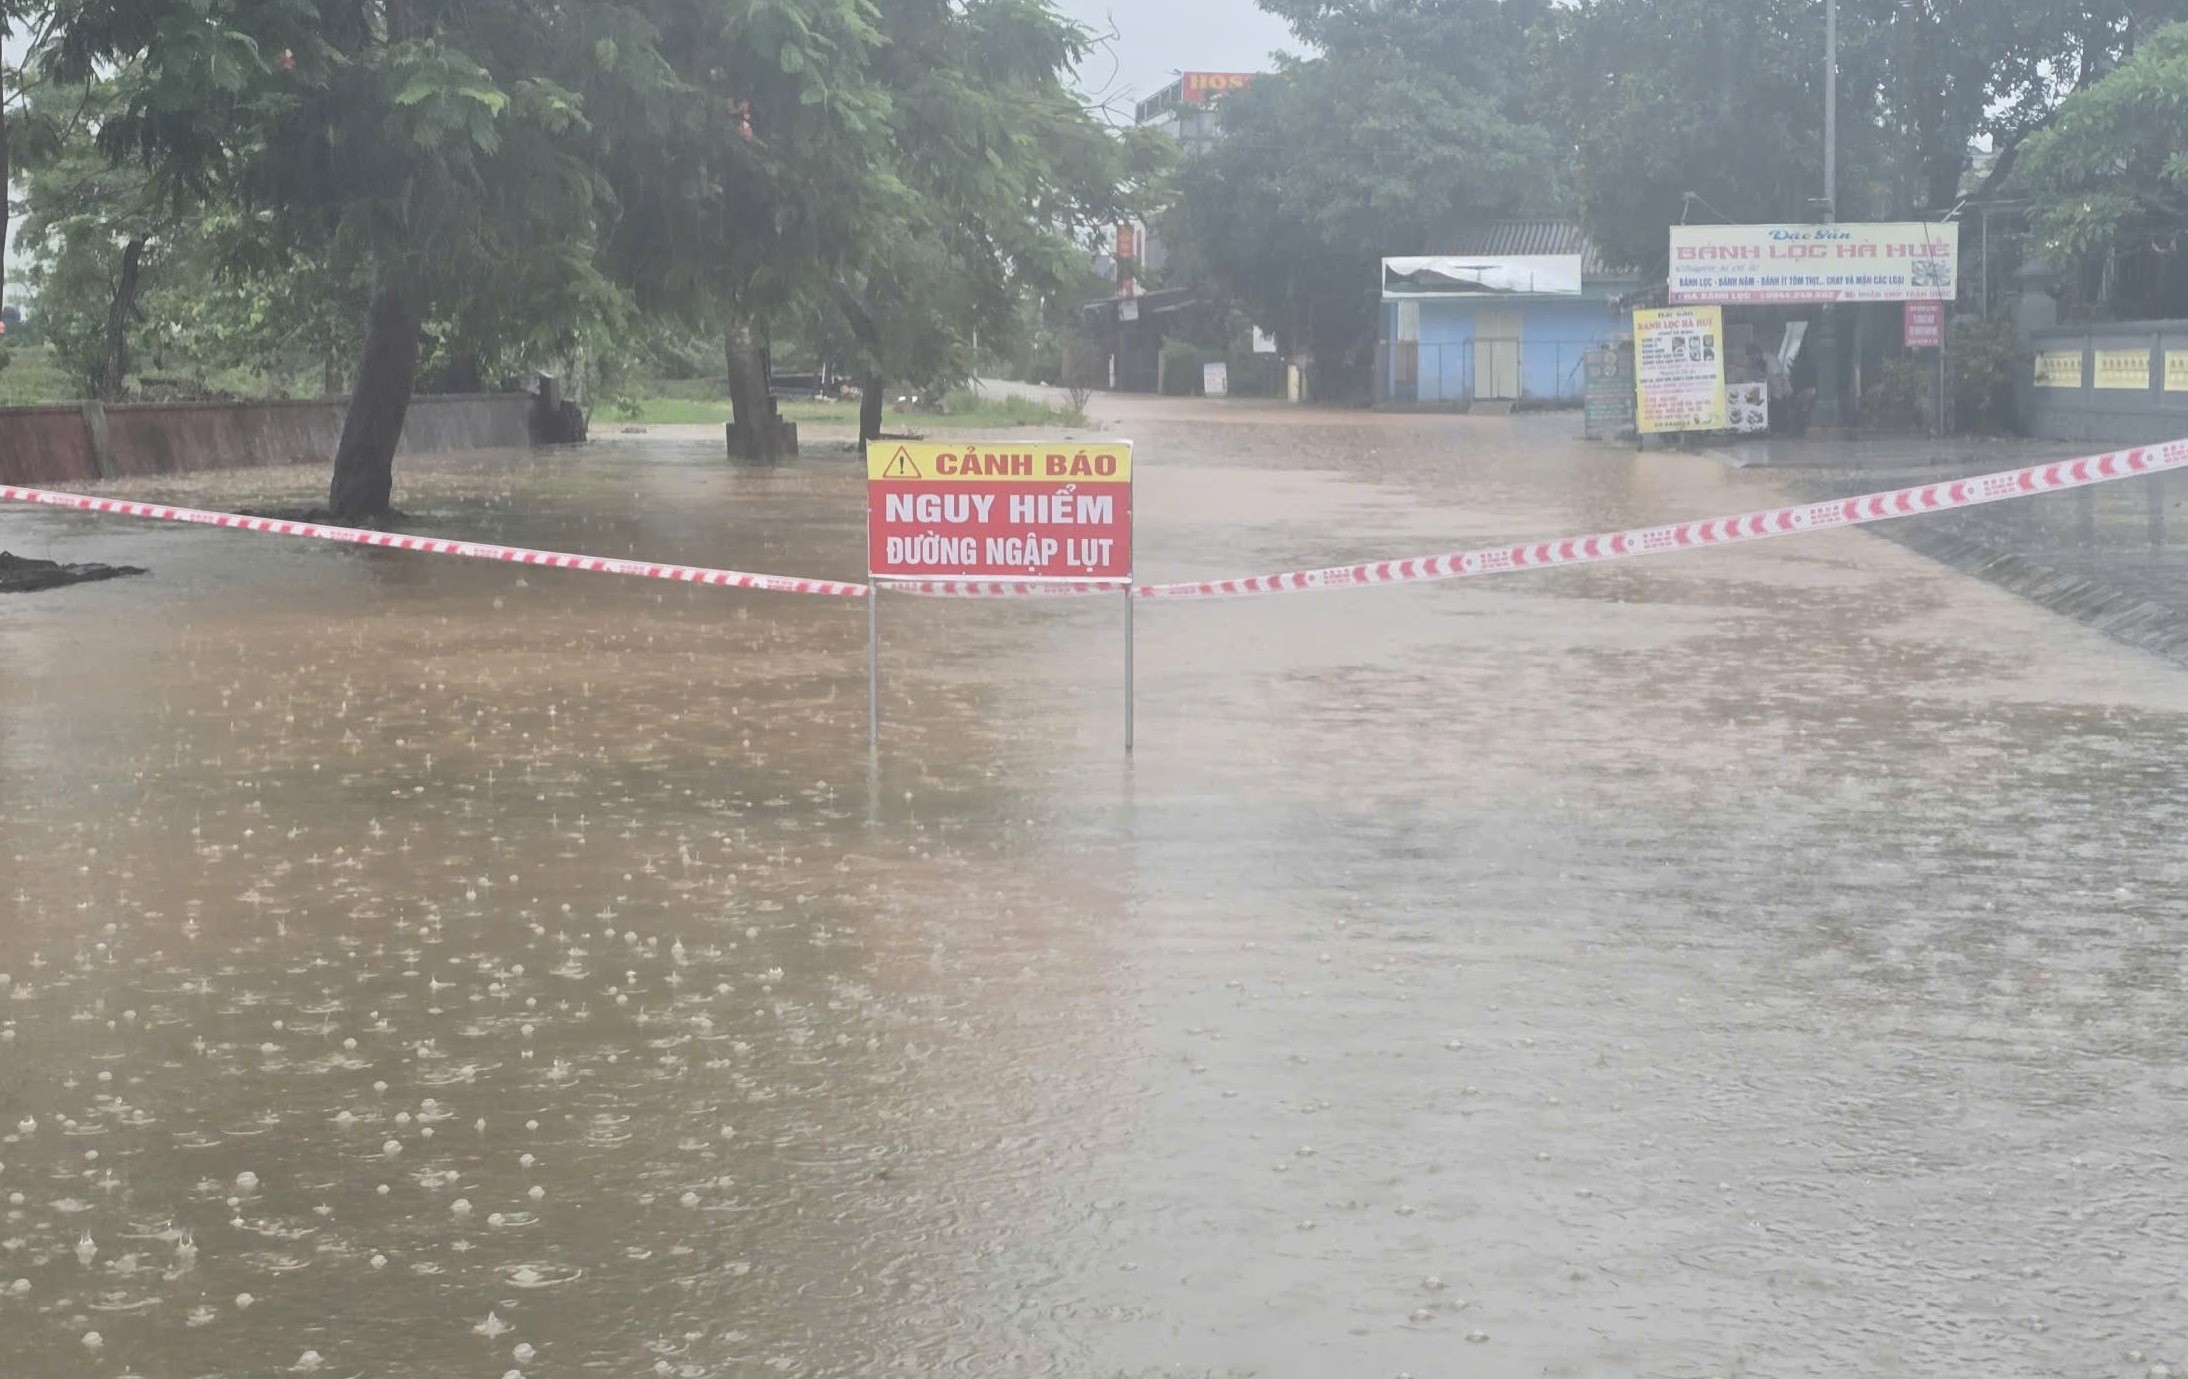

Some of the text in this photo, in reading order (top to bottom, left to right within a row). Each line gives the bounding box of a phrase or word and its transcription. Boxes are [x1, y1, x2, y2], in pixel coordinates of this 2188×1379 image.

[1189, 74, 1251, 91] HOS
[1676, 236, 1950, 262] BÁNH LỌC HÀ HUẾ
[935, 446, 1117, 476] CẢNH BÁO
[885, 484, 1113, 524] NGUY HIỂM
[886, 530, 1113, 572] ĐƯỜNG NGẬP LỤT
